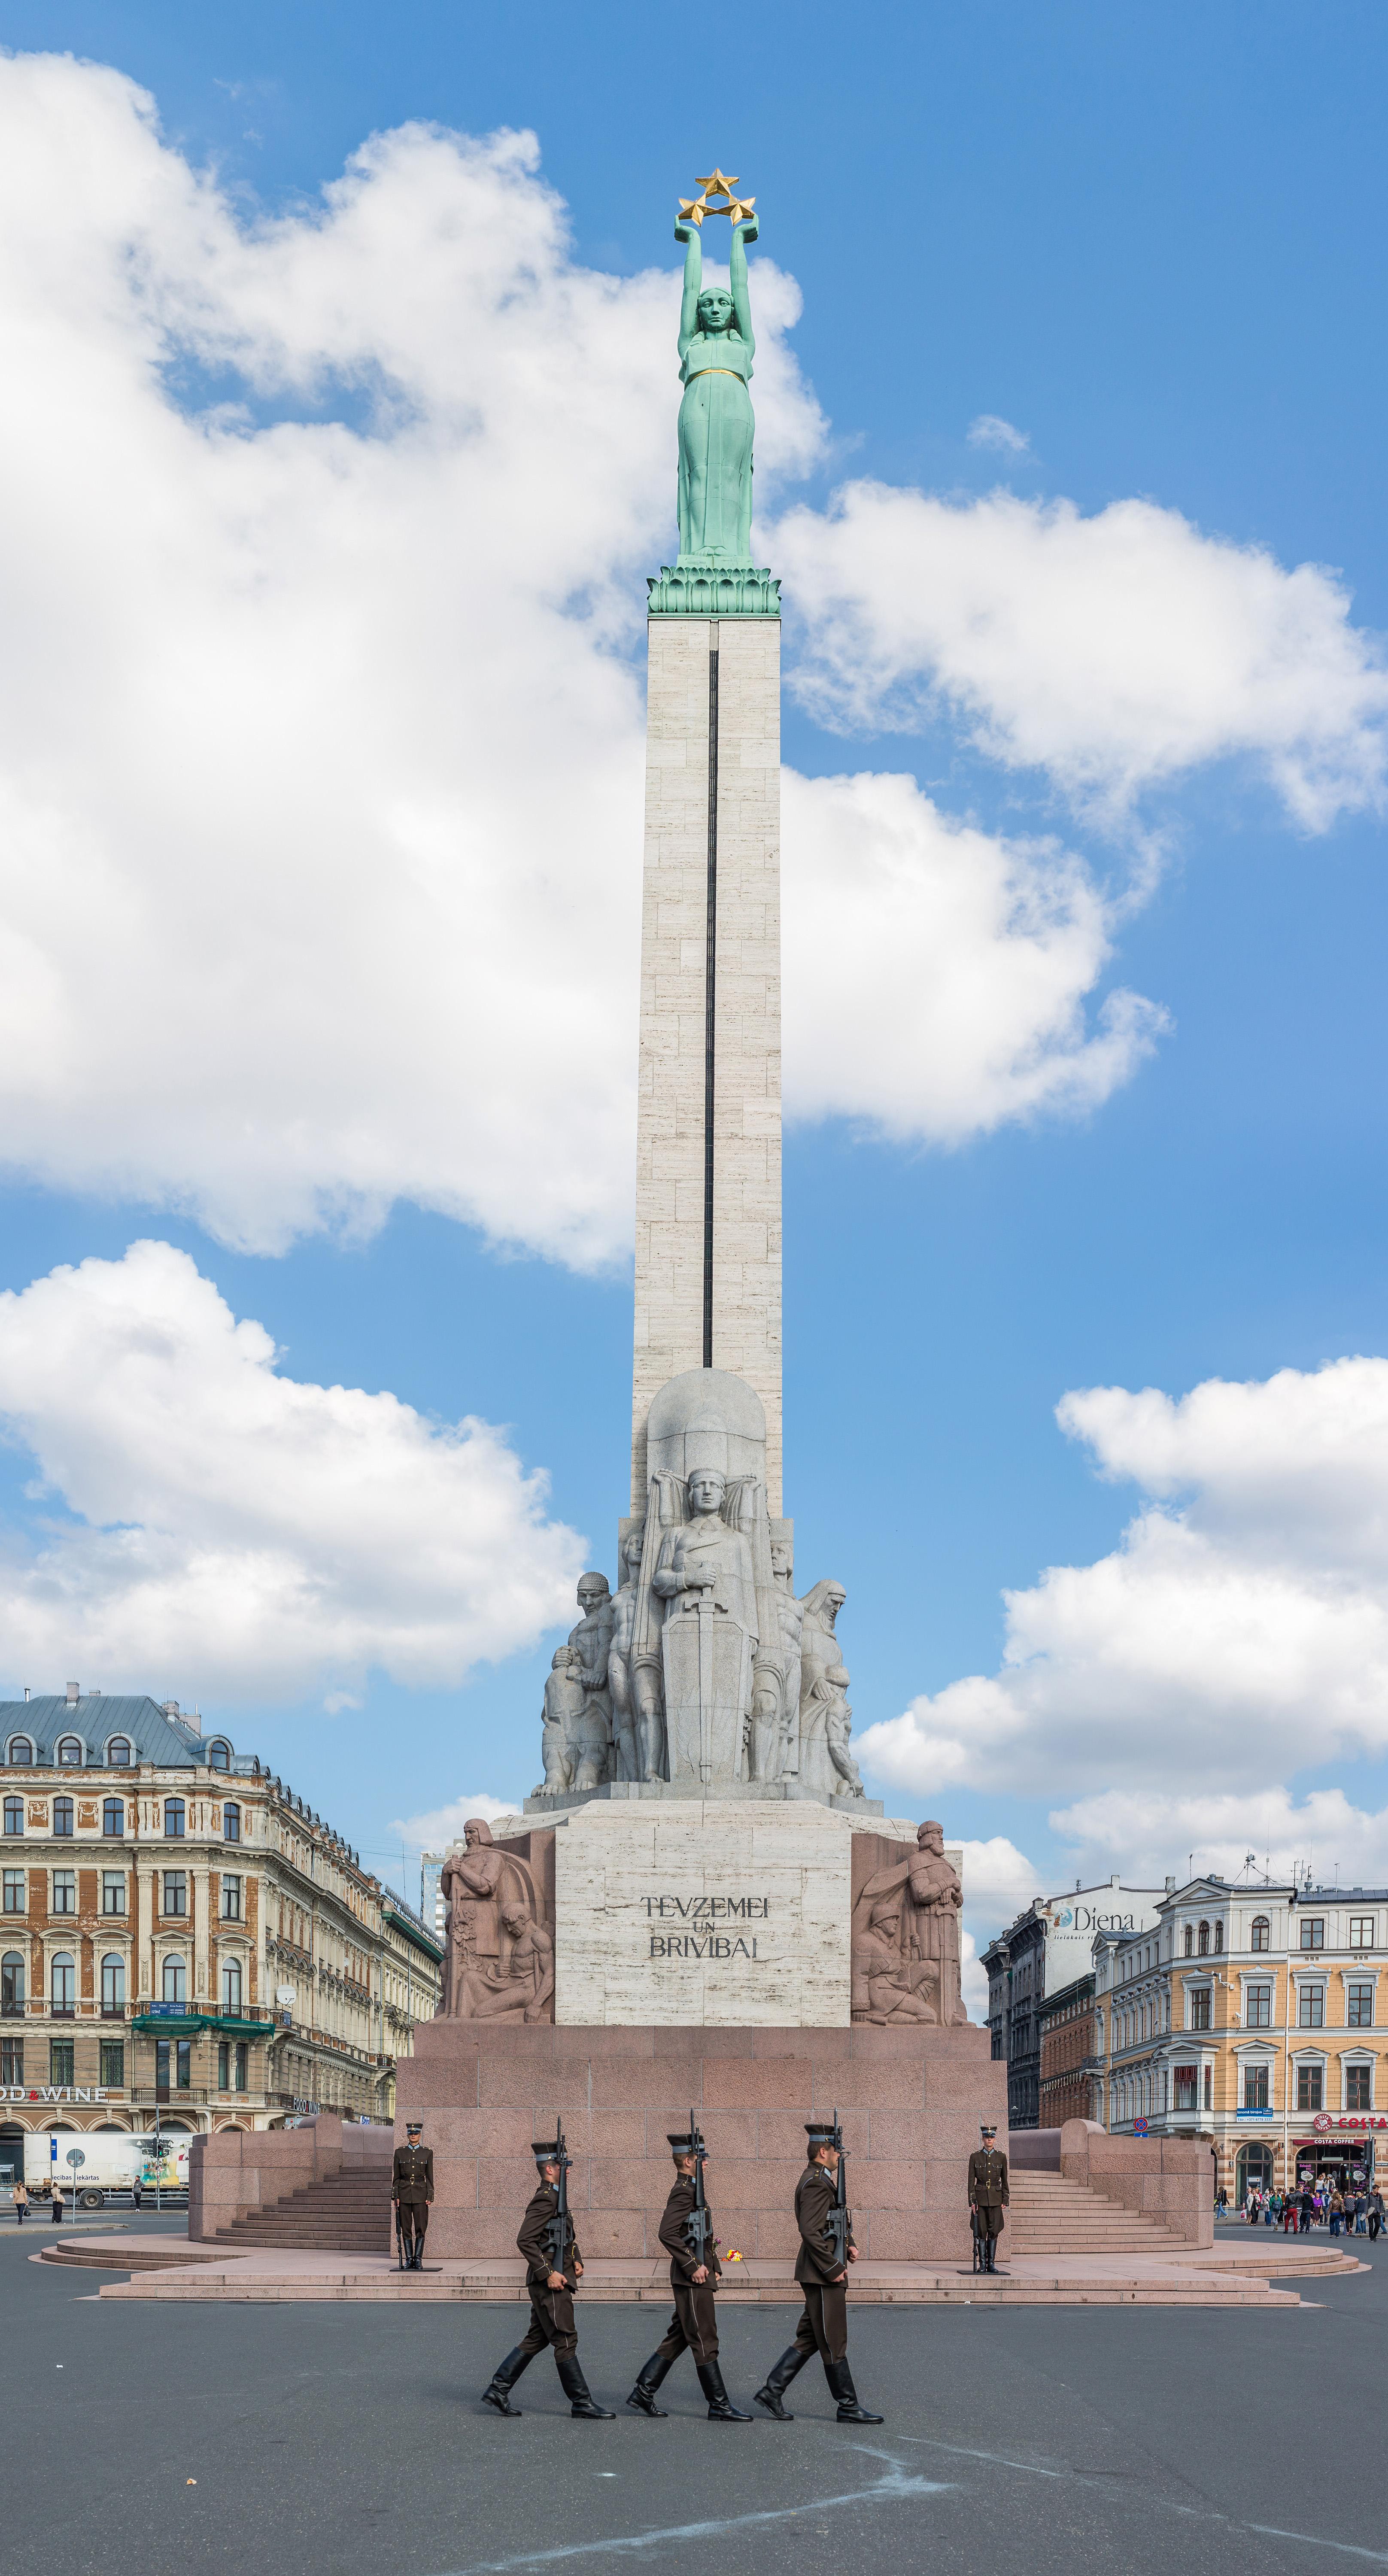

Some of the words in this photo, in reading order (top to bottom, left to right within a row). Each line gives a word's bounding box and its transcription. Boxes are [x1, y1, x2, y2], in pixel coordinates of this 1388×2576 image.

[640, 1895, 768, 1918] TĒVZEMEI
[693, 1921, 715, 1933] UN
[1072, 1907, 1135, 1931] Diena
[650, 1935, 757, 1958] BRĪVĪBAI
[40, 2087, 109, 2102] WINE
[294, 2097, 306, 2112] FOOD
[308, 2100, 320, 2114] WINE
[1339, 2118, 1387, 2130] COSTA
